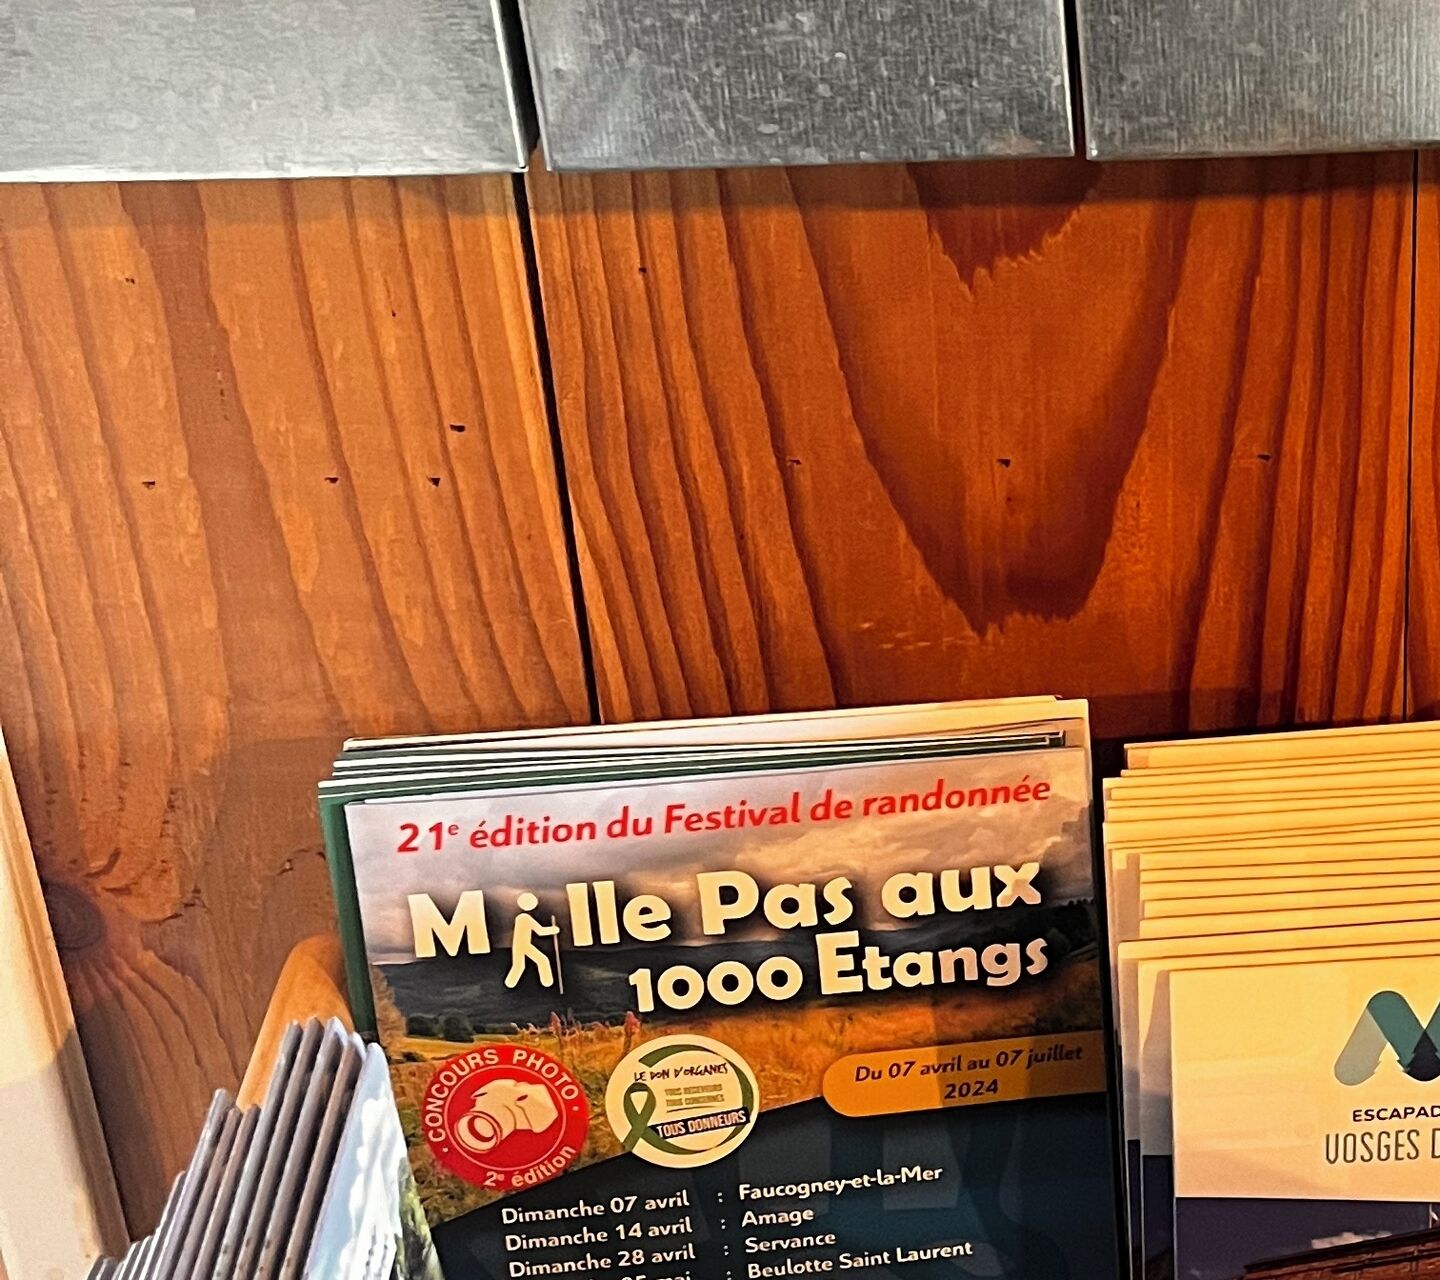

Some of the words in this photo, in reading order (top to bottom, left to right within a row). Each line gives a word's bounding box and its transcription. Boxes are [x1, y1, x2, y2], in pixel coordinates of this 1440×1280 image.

[468, 816, 595, 850] édition
[605, 812, 652, 840] du
[665, 798, 801, 835] Festival
[809, 791, 854, 822] de
[861, 775, 1051, 819] randonnée
[696, 871, 852, 935] Pas
[881, 860, 1042, 916] aux
[629, 955, 804, 1012] 1000
[816, 931, 1049, 998] Etangs
[855, 1064, 884, 1084] Du
[888, 1061, 915, 1081] 07
[920, 1056, 960, 1078] avril
[965, 1058, 991, 1074] au
[996, 1051, 1026, 1072] 07
[1031, 1044, 1084, 1075] juillet
[945, 1078, 999, 1100] 2024
[425, 1049, 499, 1142] CONCOURS
[512, 1049, 579, 1102] PHOTO
[656, 1124, 683, 1138] TOUS
[688, 1109, 746, 1131] DONNEURS
[1325, 1126, 1420, 1165] VOSGES
[511, 1145, 576, 1188] édition
[502, 1199, 605, 1224] Dimanche
[610, 1196, 637, 1213] 07
[645, 1189, 689, 1210] avril
[739, 1166, 943, 1200] Faucogney-et-la-Mer
